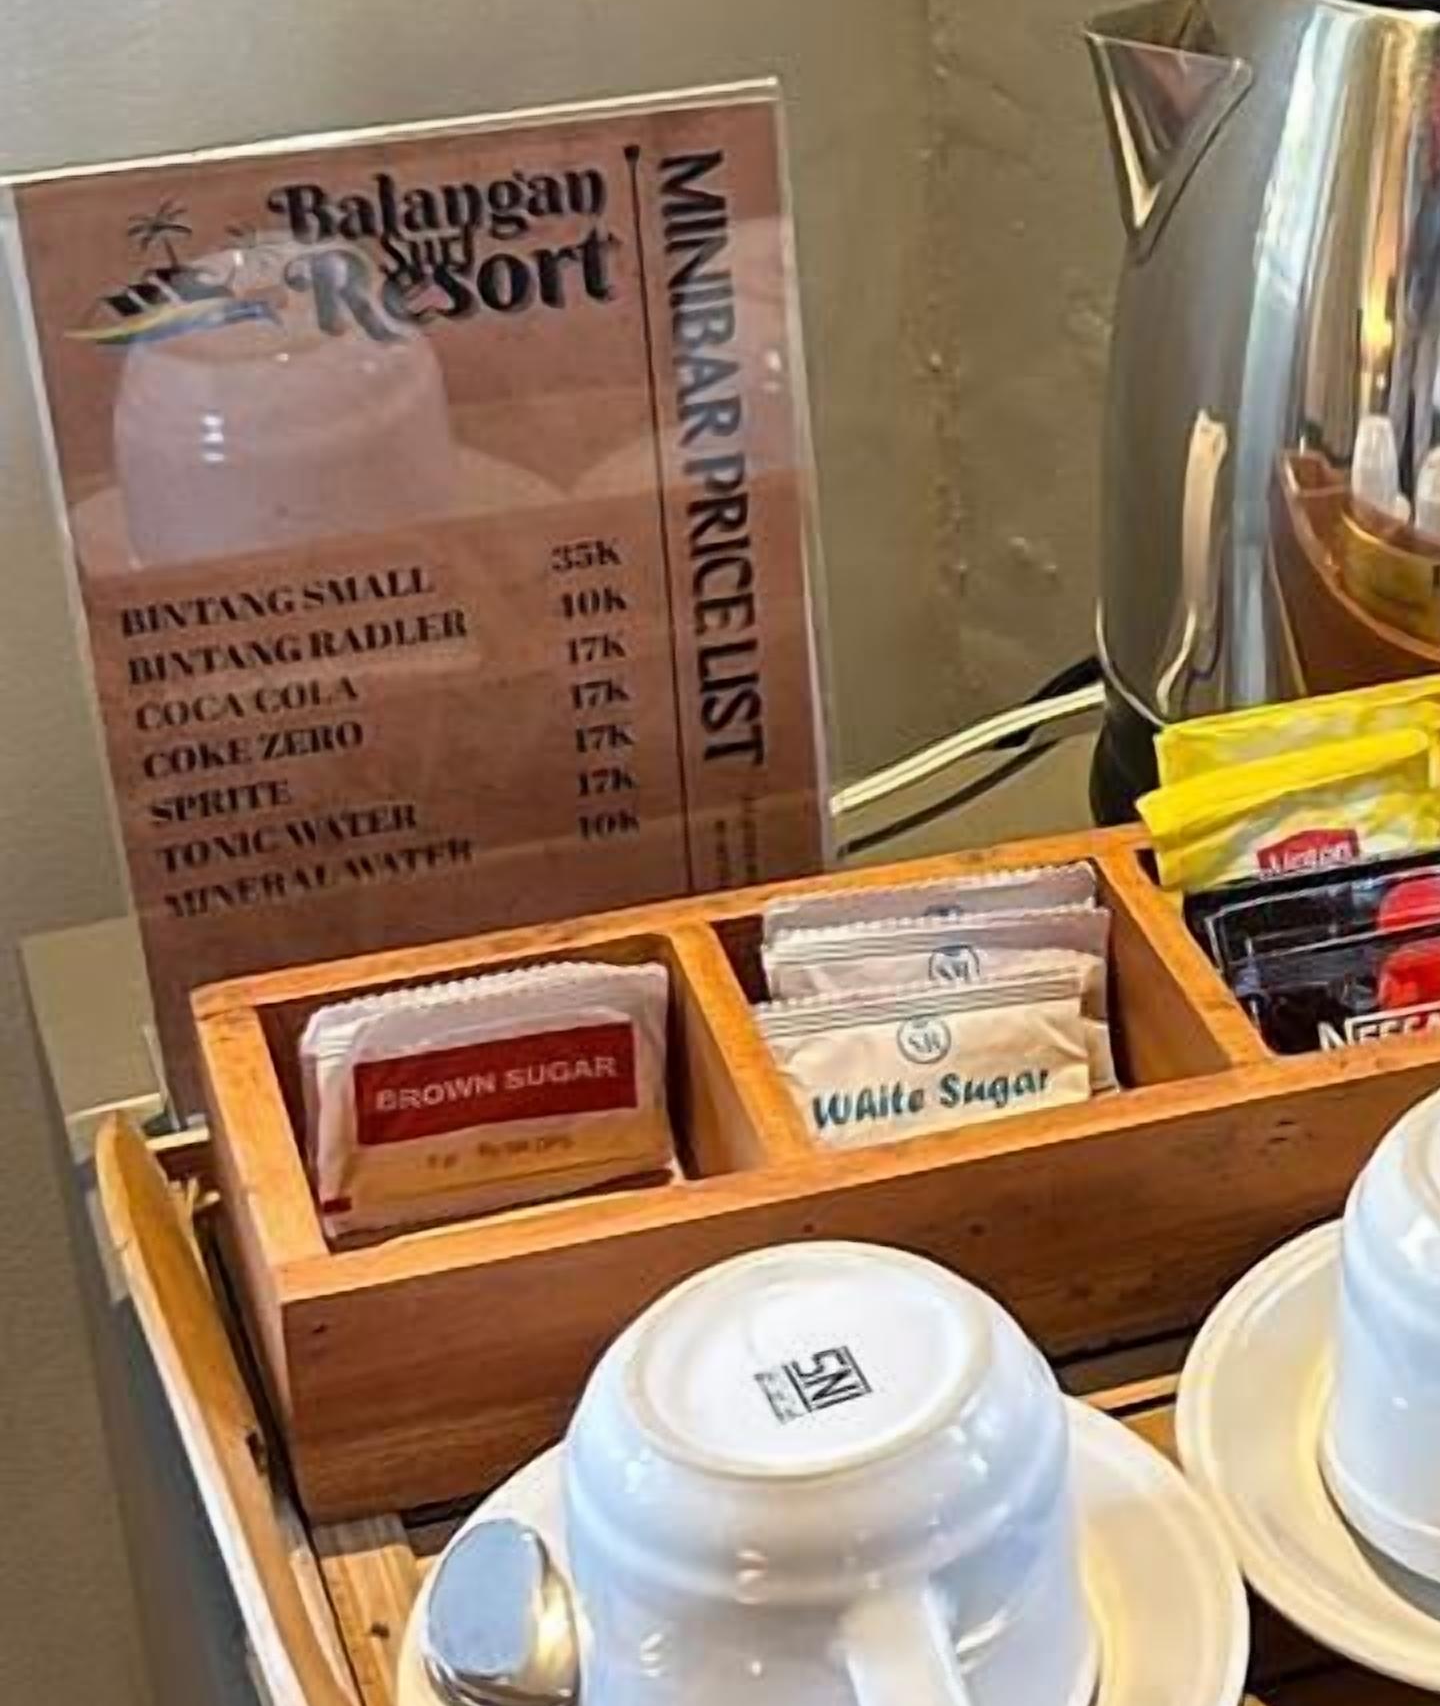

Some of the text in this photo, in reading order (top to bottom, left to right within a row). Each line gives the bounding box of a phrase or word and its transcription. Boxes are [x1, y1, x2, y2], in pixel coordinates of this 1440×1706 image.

[267, 167, 606, 242] Balangan
[284, 229, 620, 343] Resort
[658, 149, 742, 446] MINIBAR
[682, 452, 756, 636] PRICE
[120, 583, 294, 638] BINTANG
[302, 567, 435, 608] SMALL
[128, 634, 301, 685] BINTANG
[310, 608, 467, 658] RADLER
[135, 635, 627, 731] COCA COLA 17K
[697, 639, 765, 766] LIST
[144, 681, 630, 778] COKE ZERO 17K
[151, 725, 634, 825] SPRITE 17K
[161, 825, 279, 874] TONIC
[285, 803, 417, 848] WATER
[165, 861, 336, 917] MINERAL
[344, 837, 473, 881] WATER
[375, 1055, 618, 1112] BROWN SUGAR
[812, 1068, 1049, 1130] White Sugar
